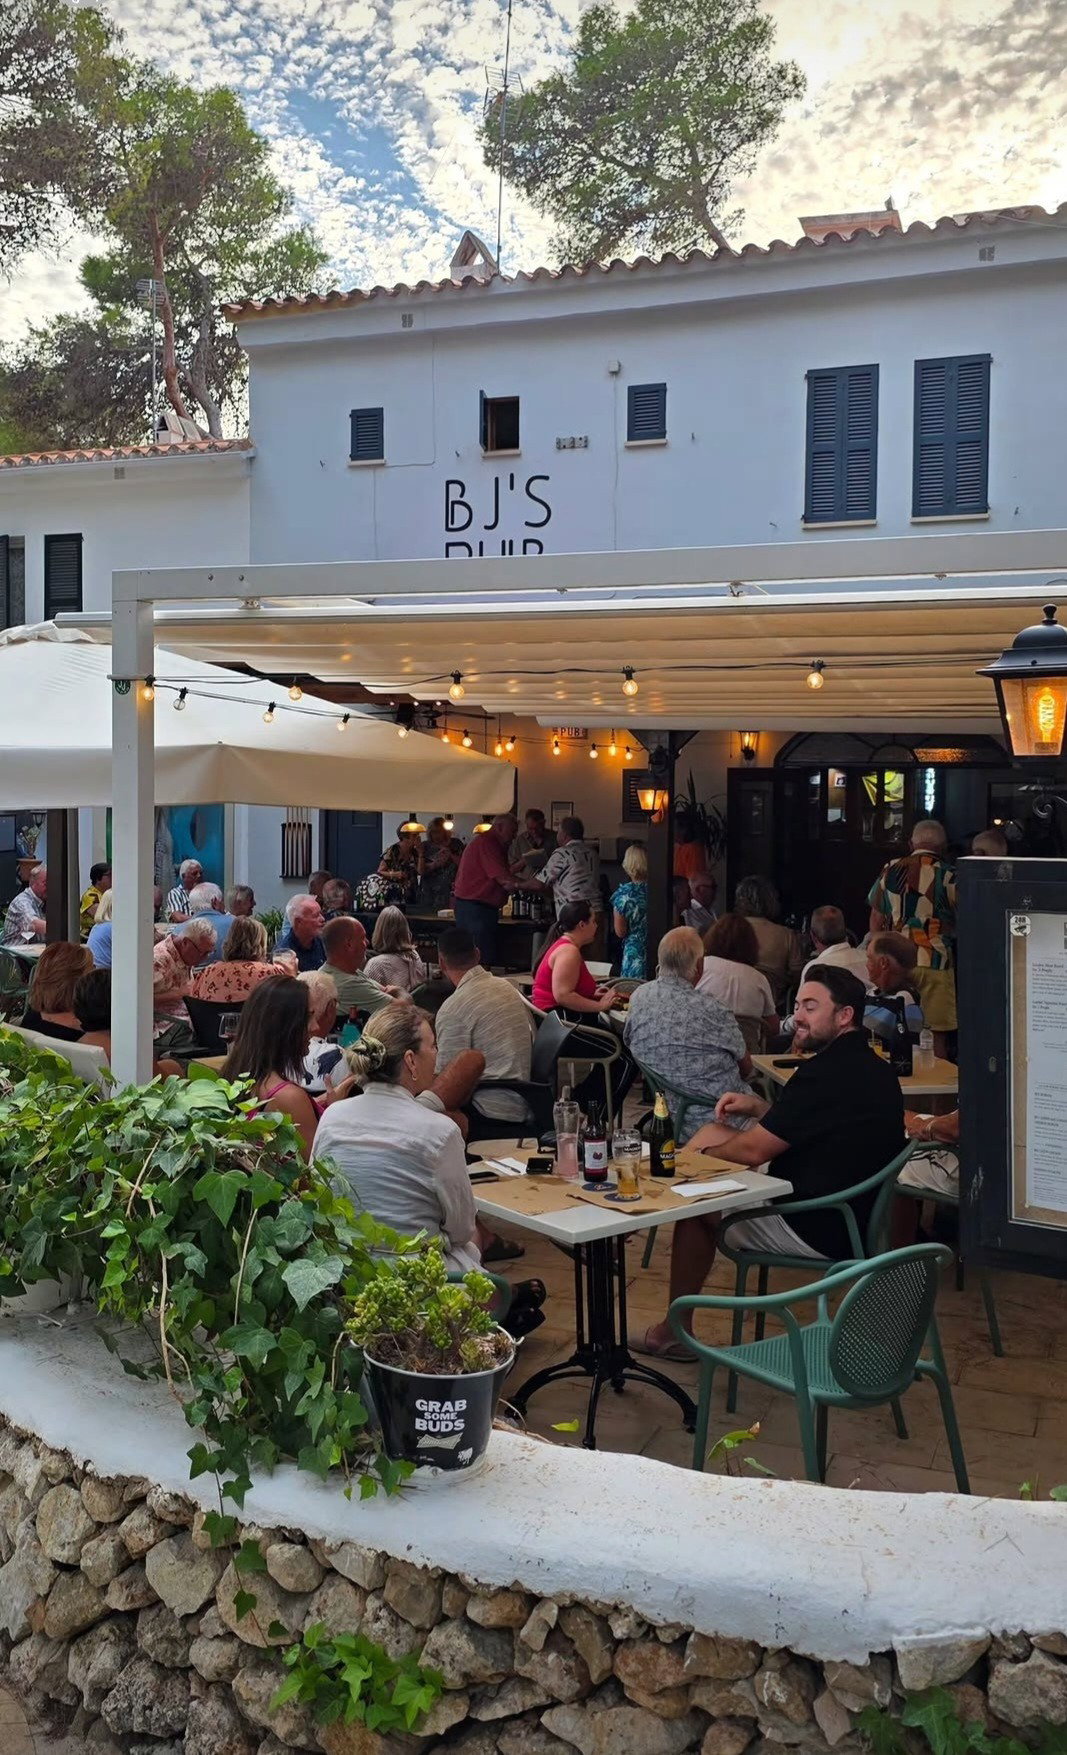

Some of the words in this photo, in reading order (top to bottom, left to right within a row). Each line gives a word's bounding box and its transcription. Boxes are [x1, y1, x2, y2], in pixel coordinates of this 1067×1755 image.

[445, 472, 552, 532] BJ'S
[560, 727, 580, 736] PUB
[415, 1399, 467, 1412] GRAB
[424, 1412, 458, 1420] SOME
[415, 1418, 465, 1432] BUDS
